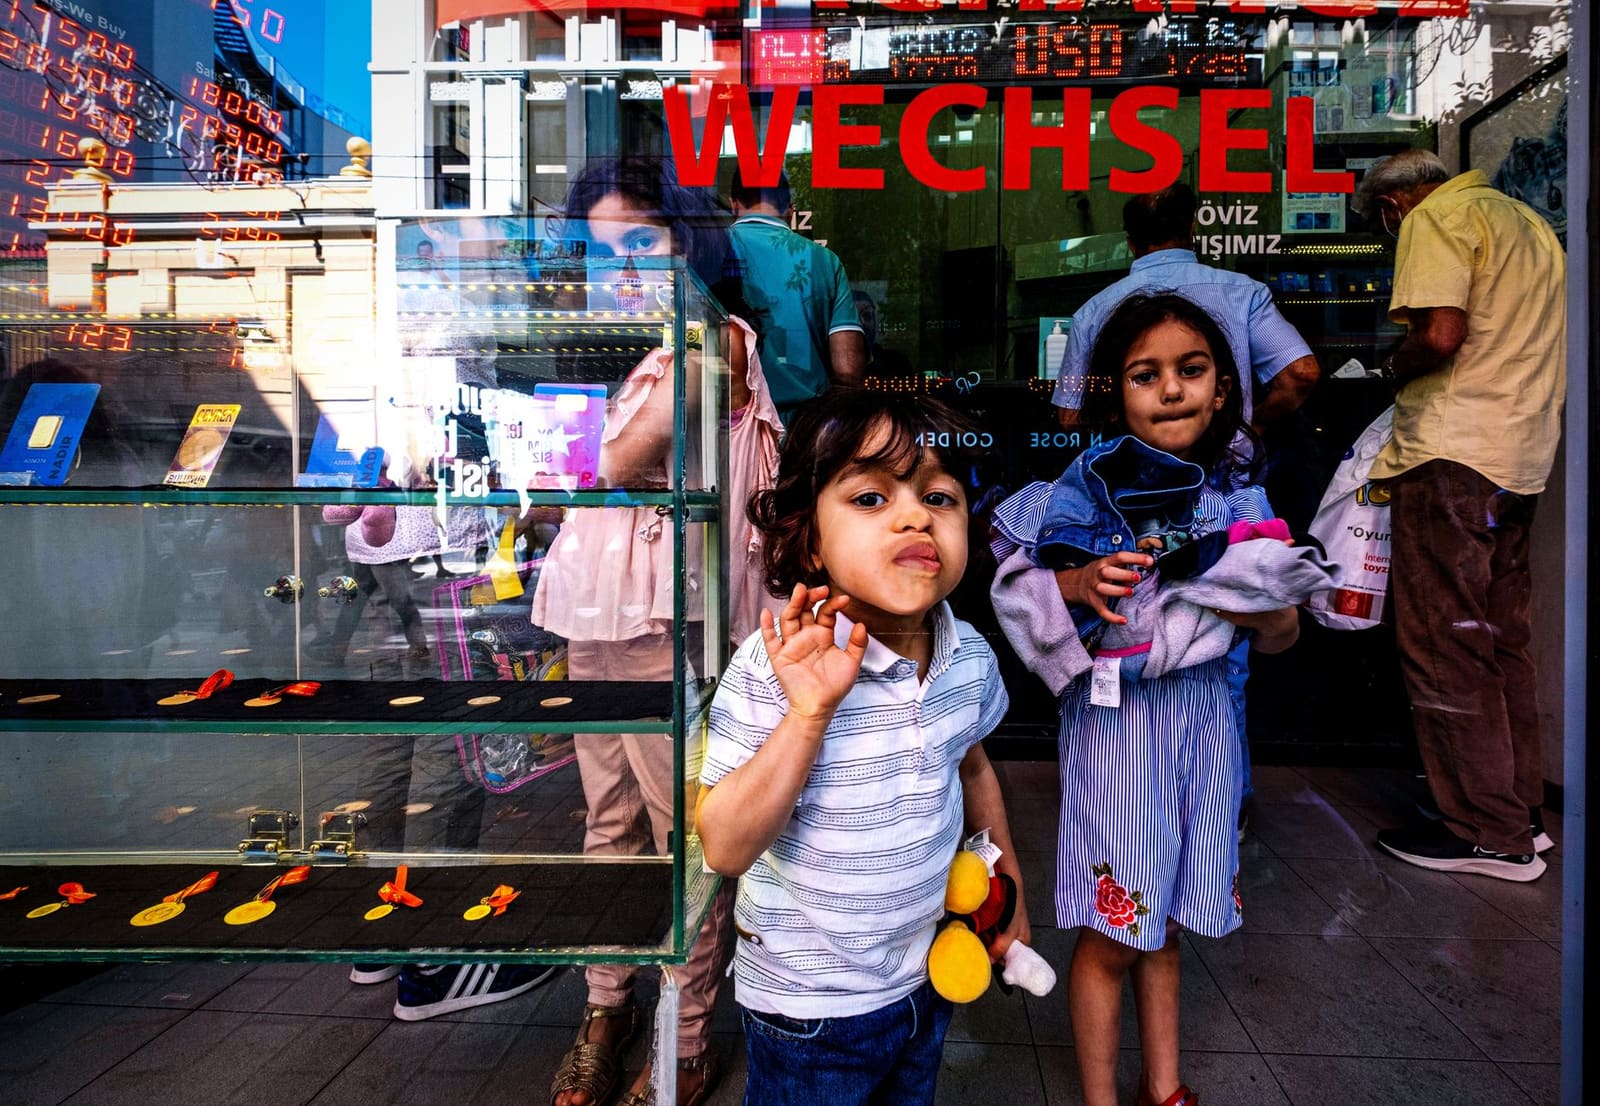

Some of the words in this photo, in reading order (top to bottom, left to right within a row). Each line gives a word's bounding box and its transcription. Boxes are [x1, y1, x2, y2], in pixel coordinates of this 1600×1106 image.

[97, 15, 127, 40] Buy
[1015, 24, 1122, 77] USD
[189, 76, 284, 132] 18000
[663, 83, 1356, 195] WECHSEL
[1195, 199, 1259, 226] ÖVİZ
[48, 436, 73, 480] NADIR
